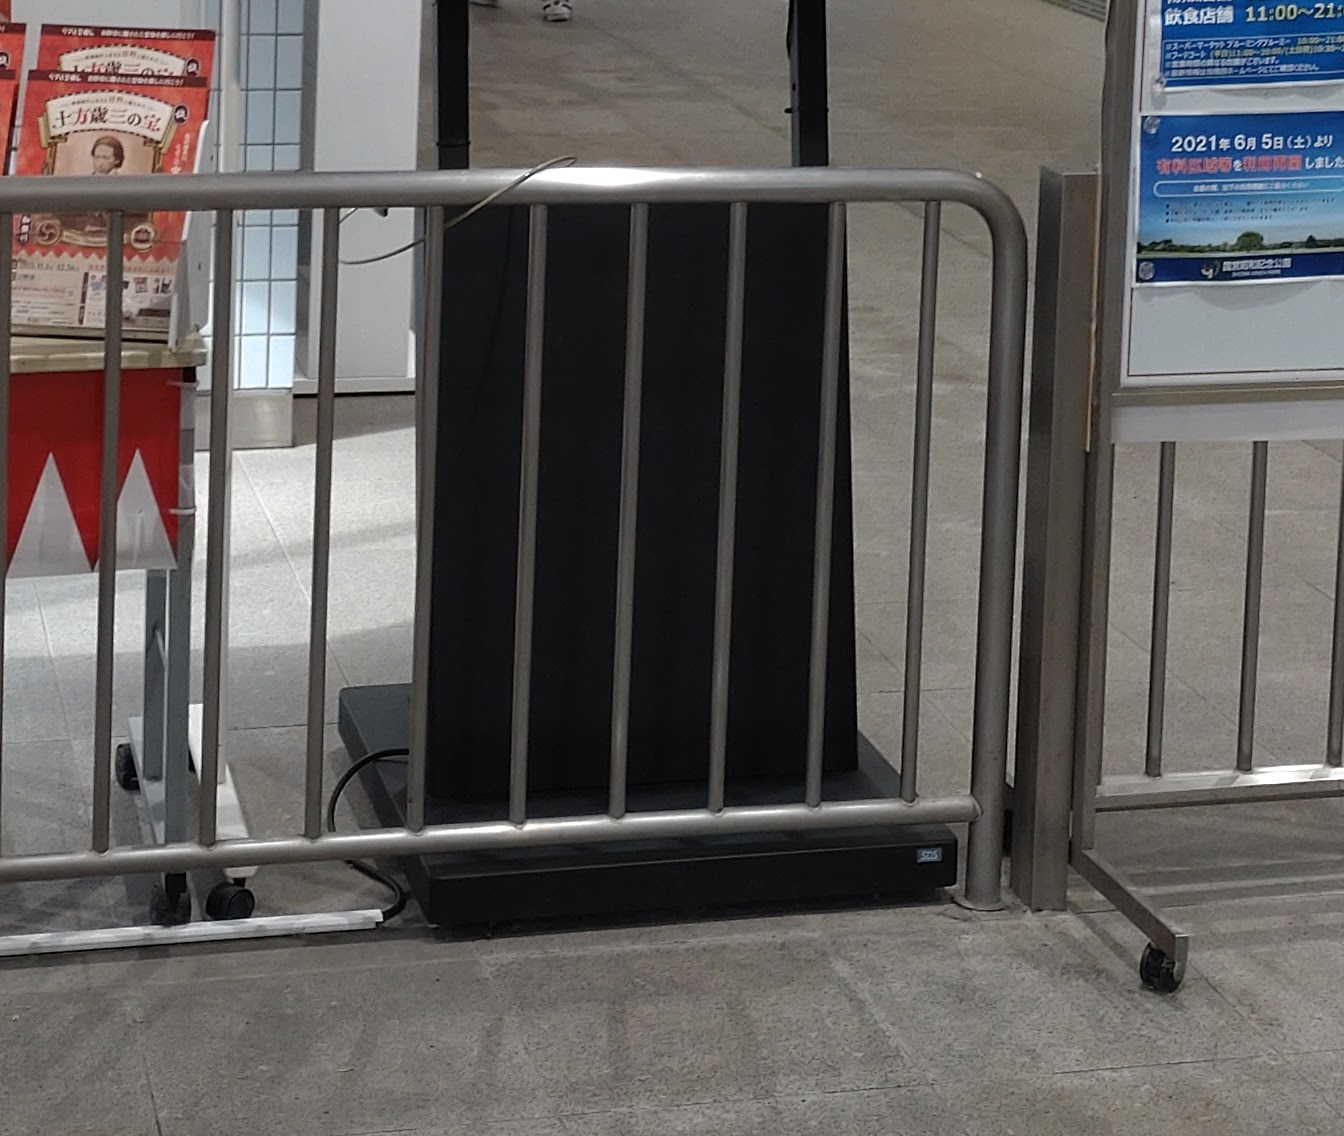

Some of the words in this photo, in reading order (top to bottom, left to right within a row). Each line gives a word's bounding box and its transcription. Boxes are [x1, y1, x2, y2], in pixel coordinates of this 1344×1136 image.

[1164, 5, 1234, 26] 飲食店舗
[52, 106, 161, 132] 土方歳三の宝
